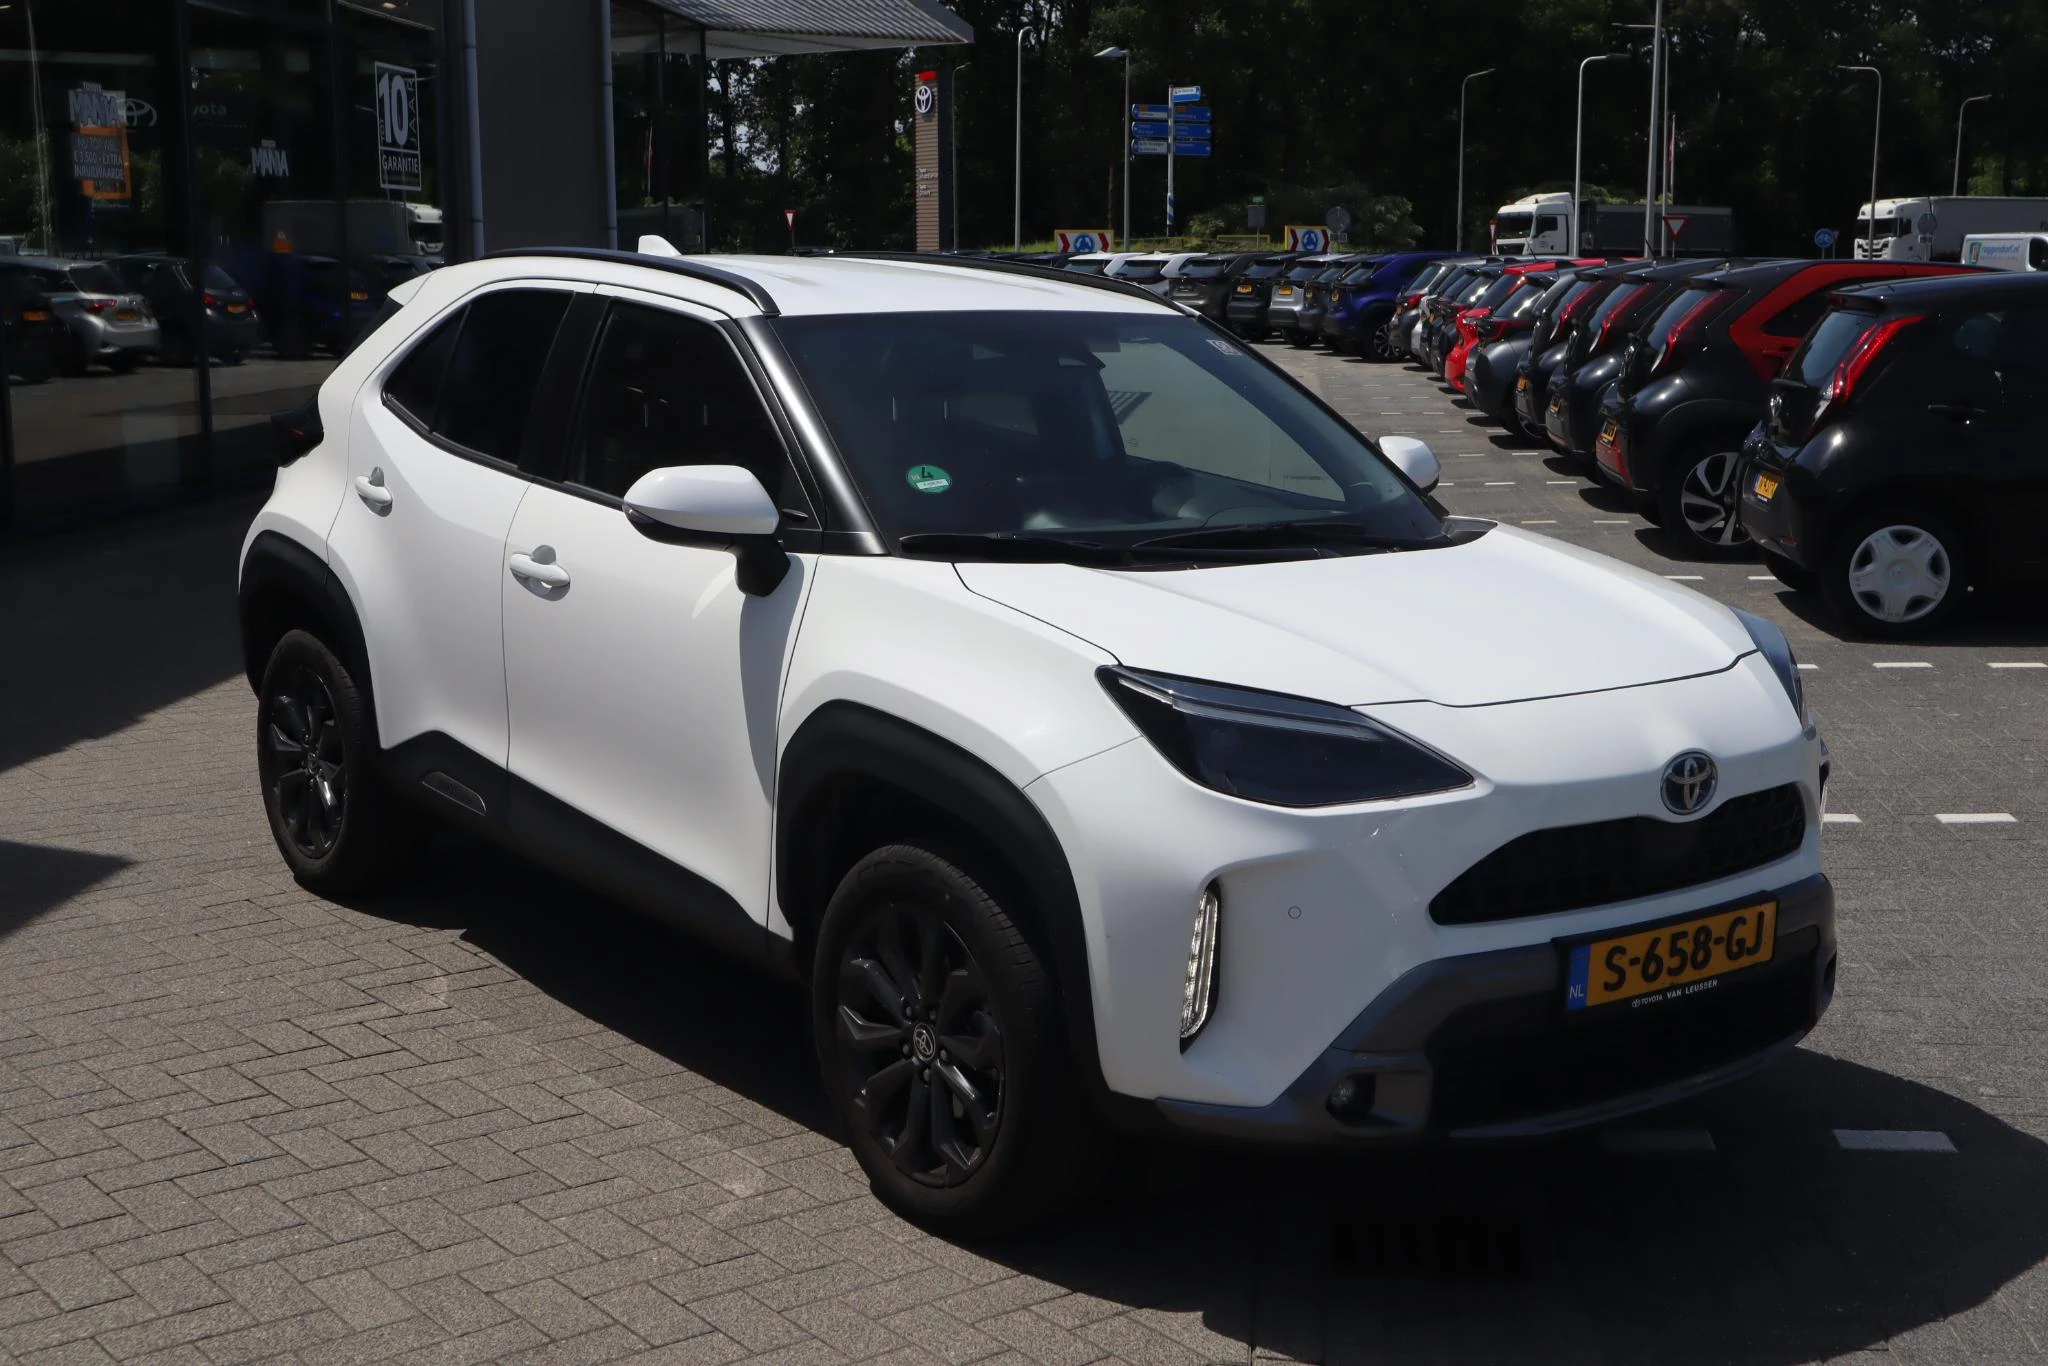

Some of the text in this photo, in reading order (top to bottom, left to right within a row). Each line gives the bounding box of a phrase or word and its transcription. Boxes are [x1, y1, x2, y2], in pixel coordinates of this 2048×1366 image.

[379, 72, 408, 145] 10
[407, 78, 417, 145] JAAR
[251, 146, 289, 177] MANIA
[382, 154, 419, 173] GARANTIE
[1603, 911, 1765, 992] S-658-GJ
[1569, 984, 1585, 999] NL
[1641, 979, 1718, 1005] TOYOTA VAN LEUSSEN
